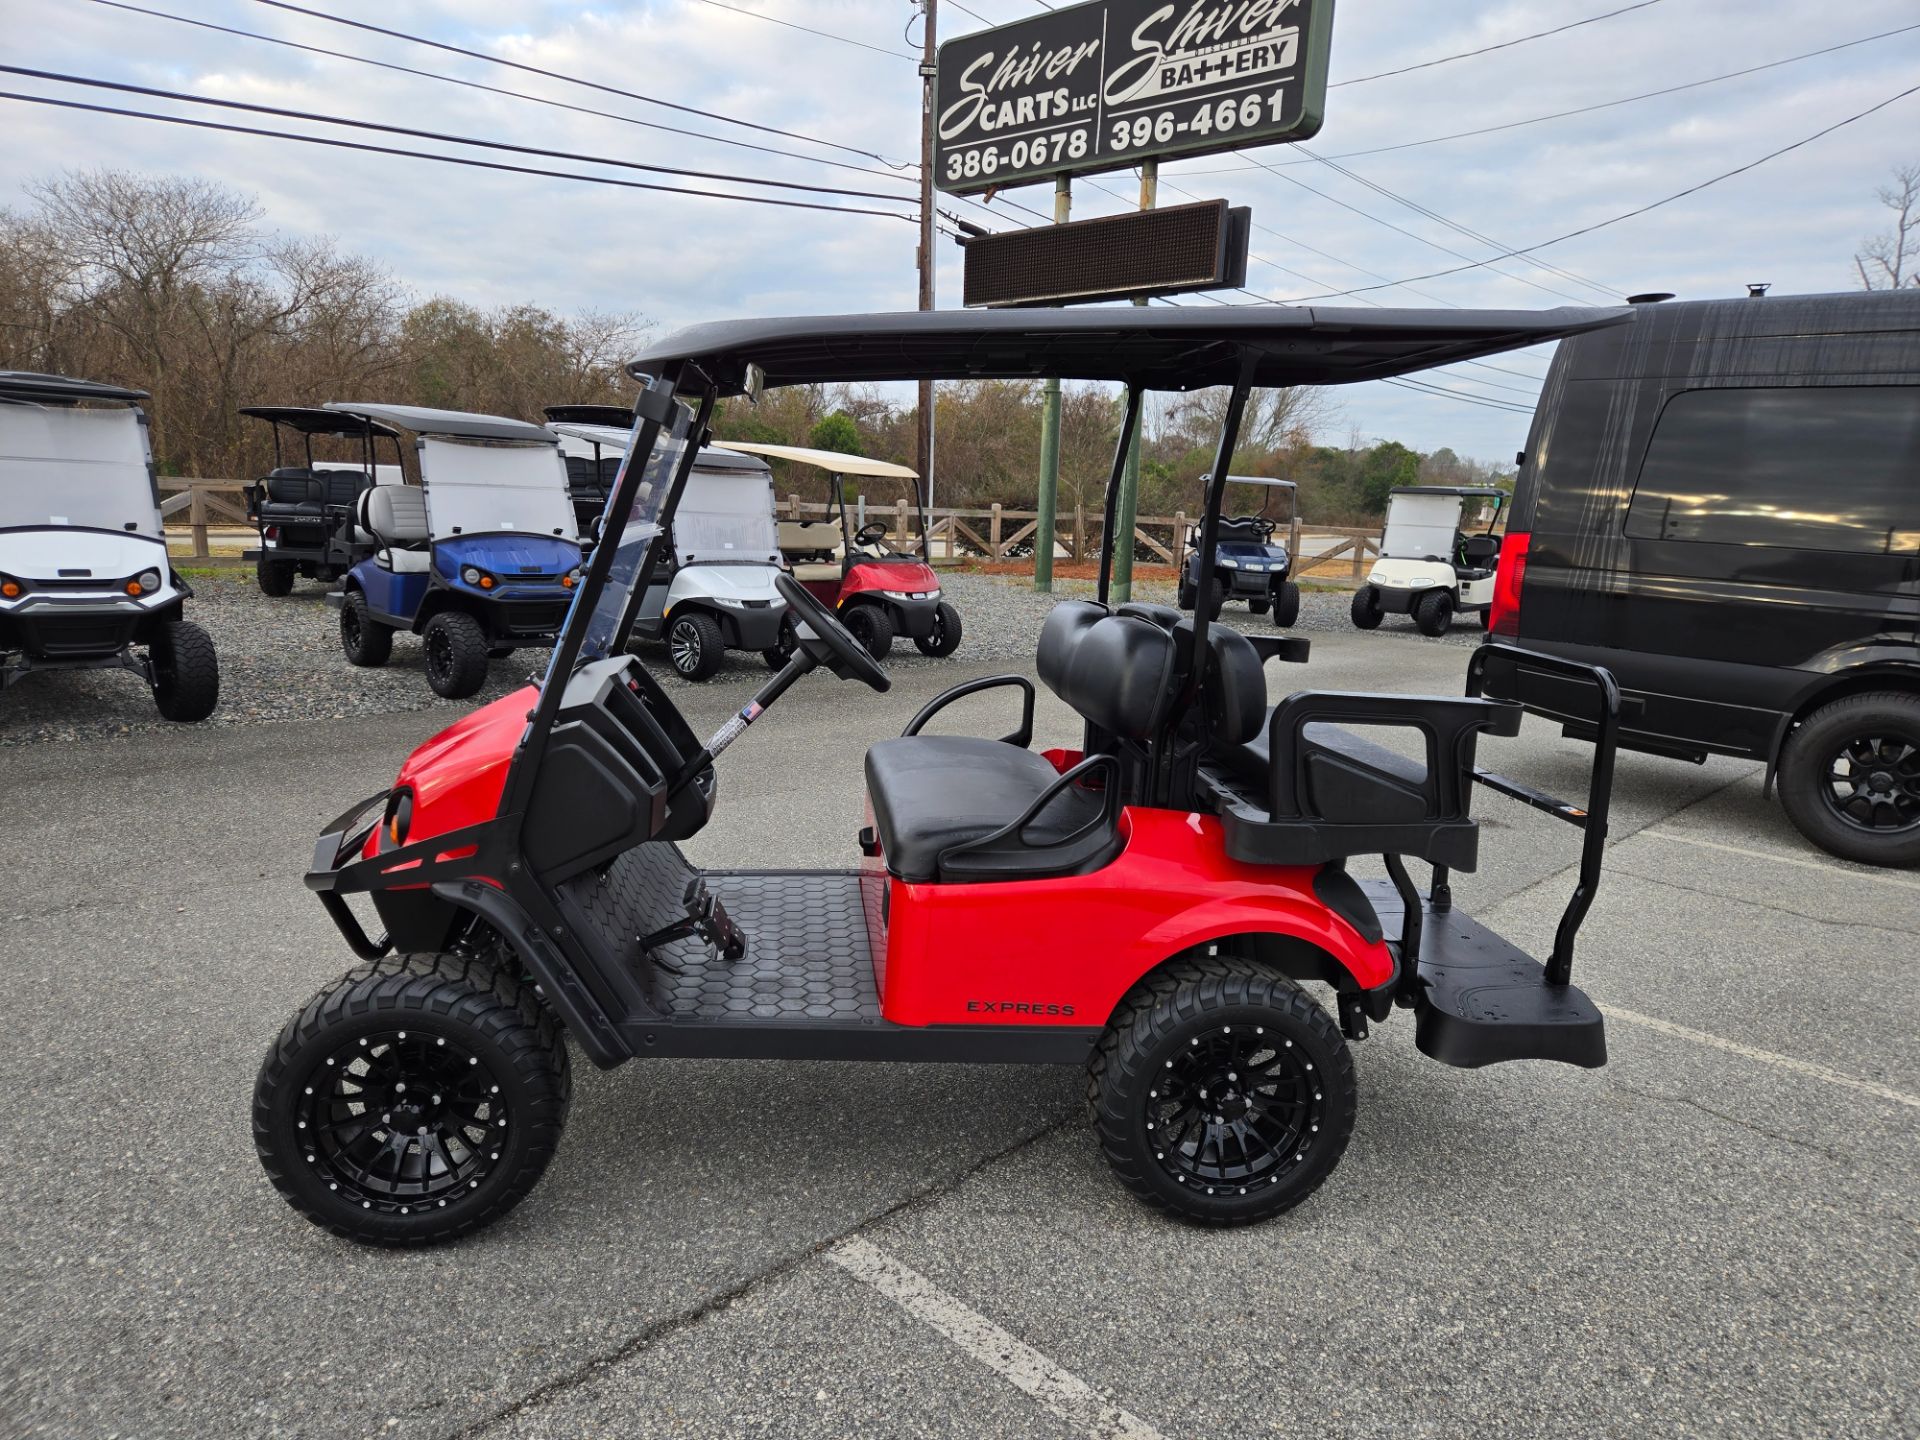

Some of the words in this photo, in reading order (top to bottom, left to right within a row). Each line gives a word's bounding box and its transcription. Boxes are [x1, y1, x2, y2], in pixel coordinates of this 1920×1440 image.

[1104, 0, 1300, 106] Shiver
[939, 38, 1100, 140] Shiver
[979, 87, 1070, 131] CARTS
[1072, 93, 1097, 112] LLC
[1110, 88, 1284, 151] 396-4661
[946, 128, 1088, 180] 386-0678
[966, 1000, 1076, 1017] EXPRESS
